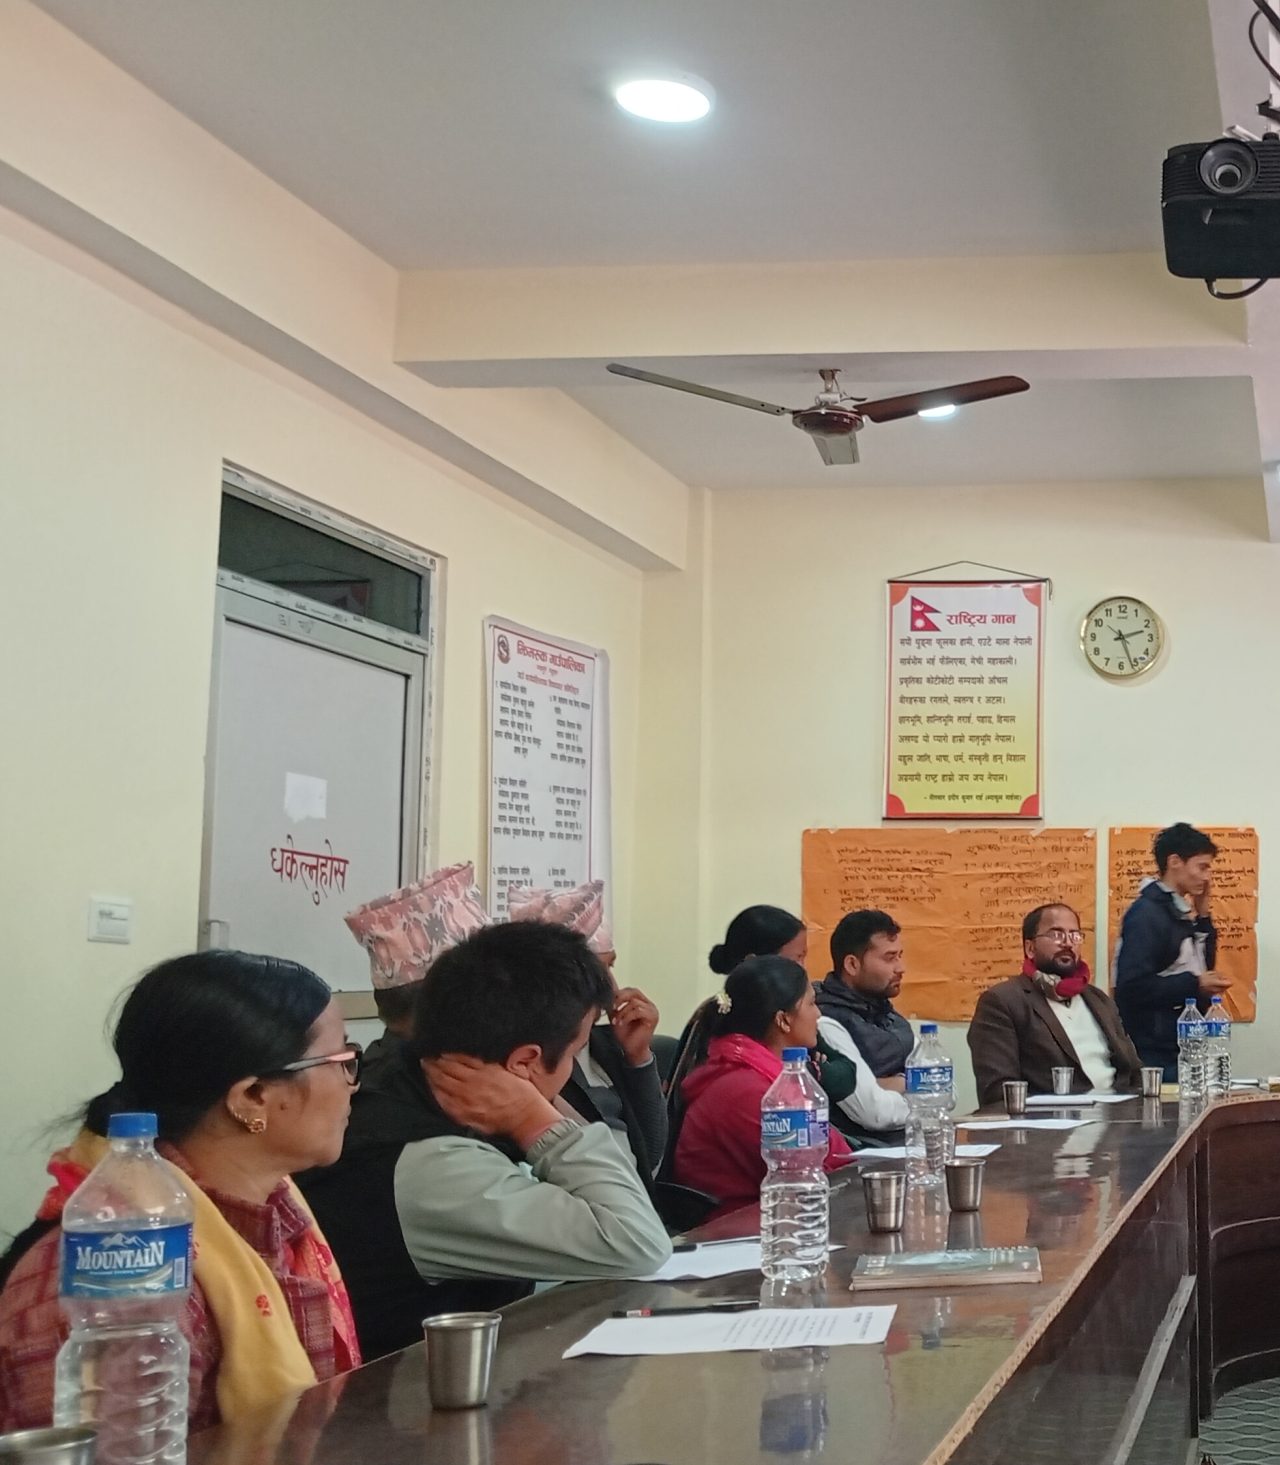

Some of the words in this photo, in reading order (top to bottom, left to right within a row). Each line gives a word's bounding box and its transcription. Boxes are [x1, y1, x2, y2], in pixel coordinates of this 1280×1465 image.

[1105, 608, 1112, 617] 11
[1118, 604, 1128, 613] 12
[1134, 609, 1138, 617] 1
[991, 614, 1016, 624] गान
[1094, 618, 1103, 627] 10
[1144, 619, 1151, 628] 2
[1090, 633, 1096, 641] 9
[1147, 633, 1153, 642] 3
[1094, 647, 1100, 656] 8
[1143, 648, 1149, 656] 4
[1104, 657, 1110, 666] 7
[1118, 661, 1124, 670] 6
[1133, 658, 1139, 666] 5
[76, 1241, 166, 1270] MOUNTAIN
